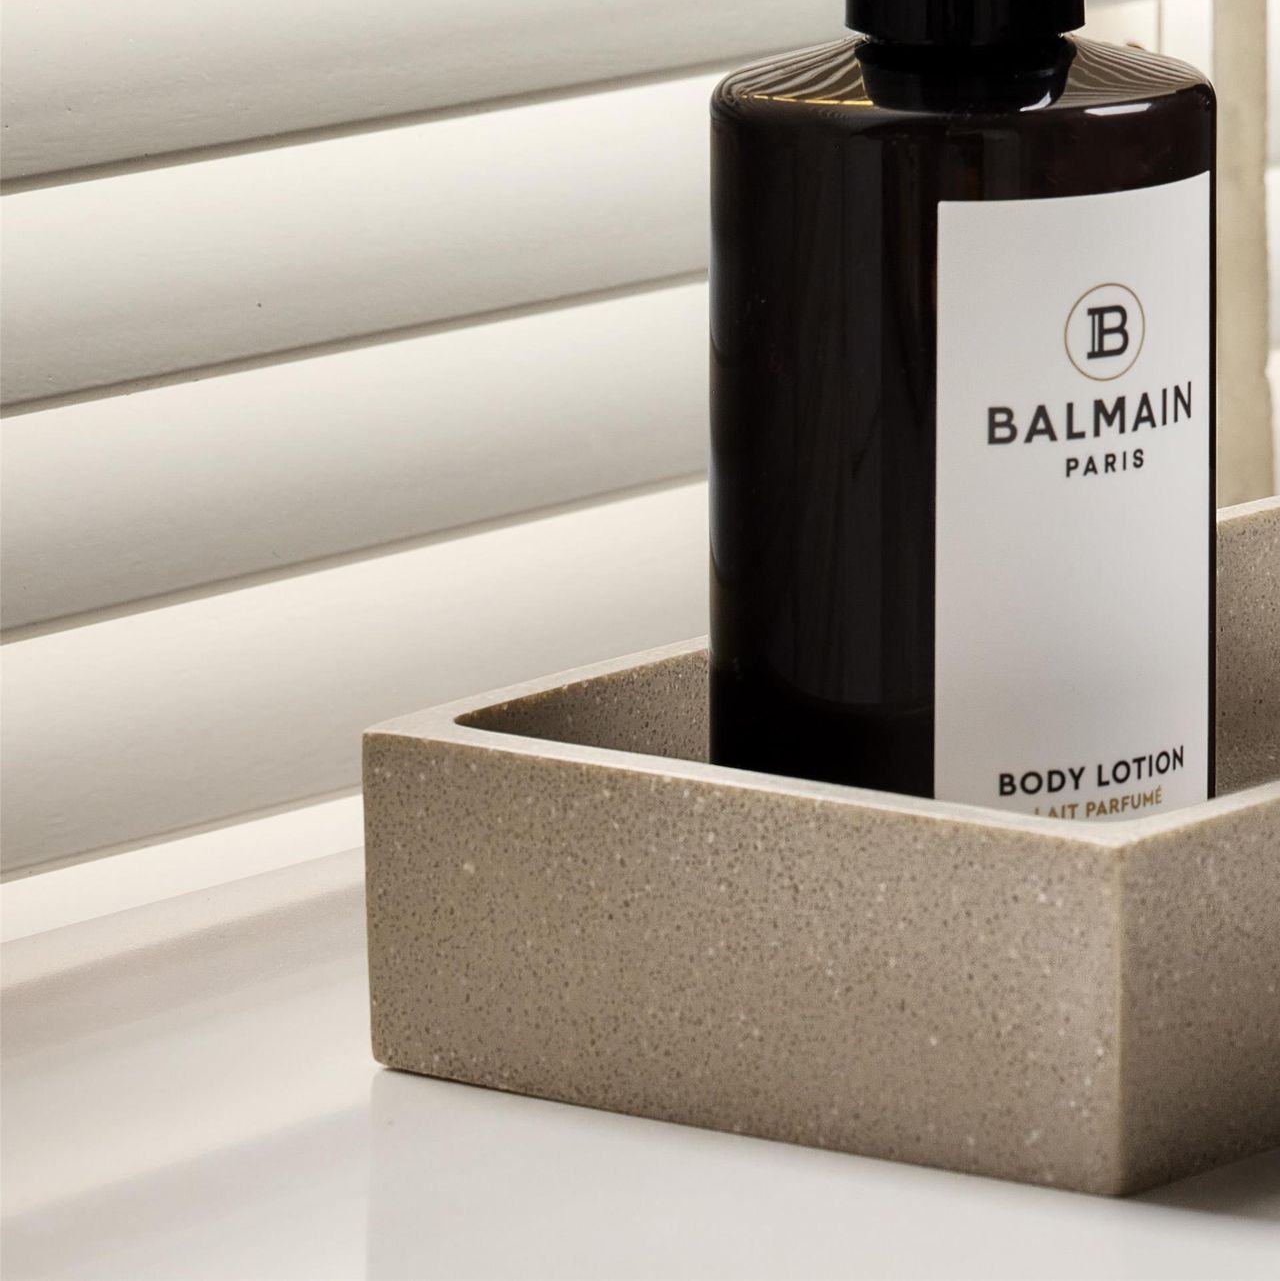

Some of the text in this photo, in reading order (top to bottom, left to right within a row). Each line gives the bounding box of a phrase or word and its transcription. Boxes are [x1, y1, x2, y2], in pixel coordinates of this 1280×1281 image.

[986, 381, 1192, 445] BALMAIN
[1065, 449, 1145, 478] PARIS
[998, 745, 1184, 797] BODY LOTION
[1085, 785, 1162, 818] PARFUMÉ
